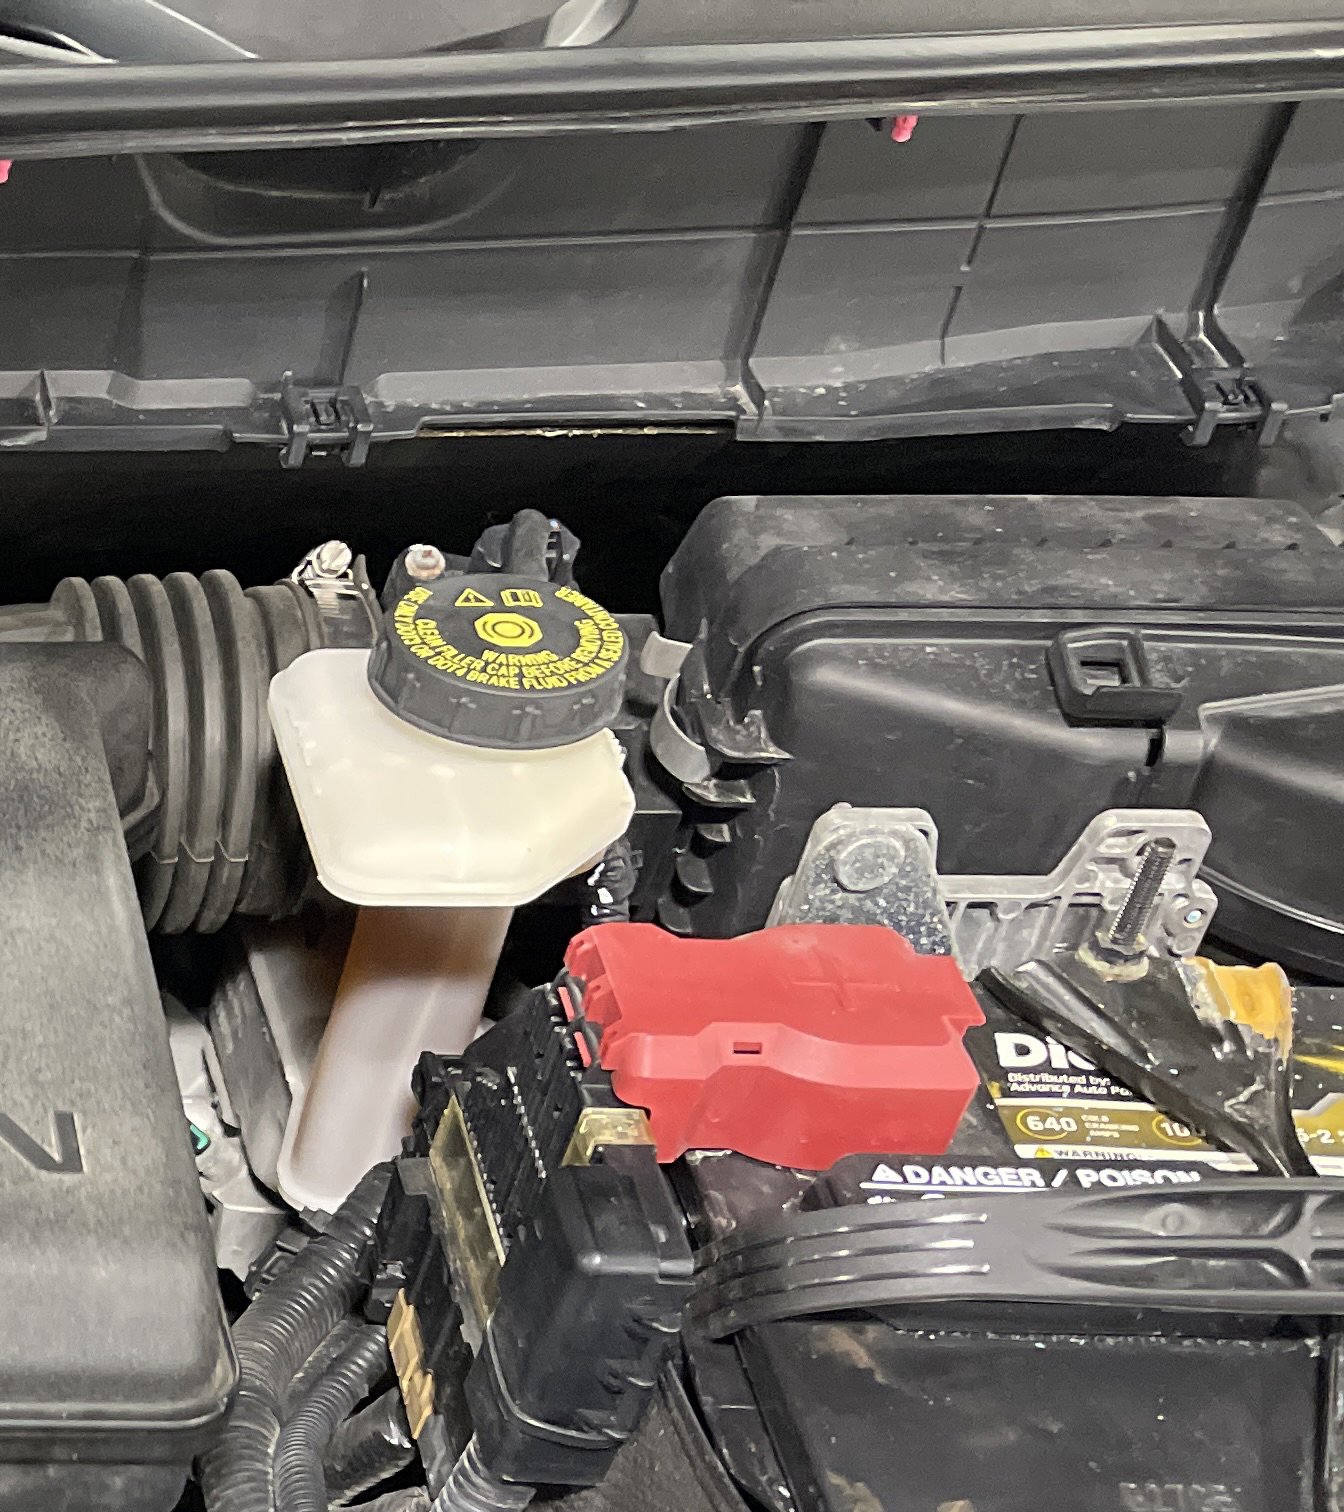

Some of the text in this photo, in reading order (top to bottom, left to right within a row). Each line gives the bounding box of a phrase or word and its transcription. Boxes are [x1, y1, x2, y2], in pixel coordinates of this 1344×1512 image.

[481, 649, 559, 667] WARNING
[486, 662, 520, 677] CAP
[522, 656, 584, 678] BEFORE
[466, 669, 520, 689] BRAKE
[522, 676, 568, 690] FLUID
[564, 662, 606, 685] FROM
[1073, 1084, 1108, 1095] Auto
[1026, 1115, 1078, 1132] 640
[902, 1164, 1045, 1188] DANGER
